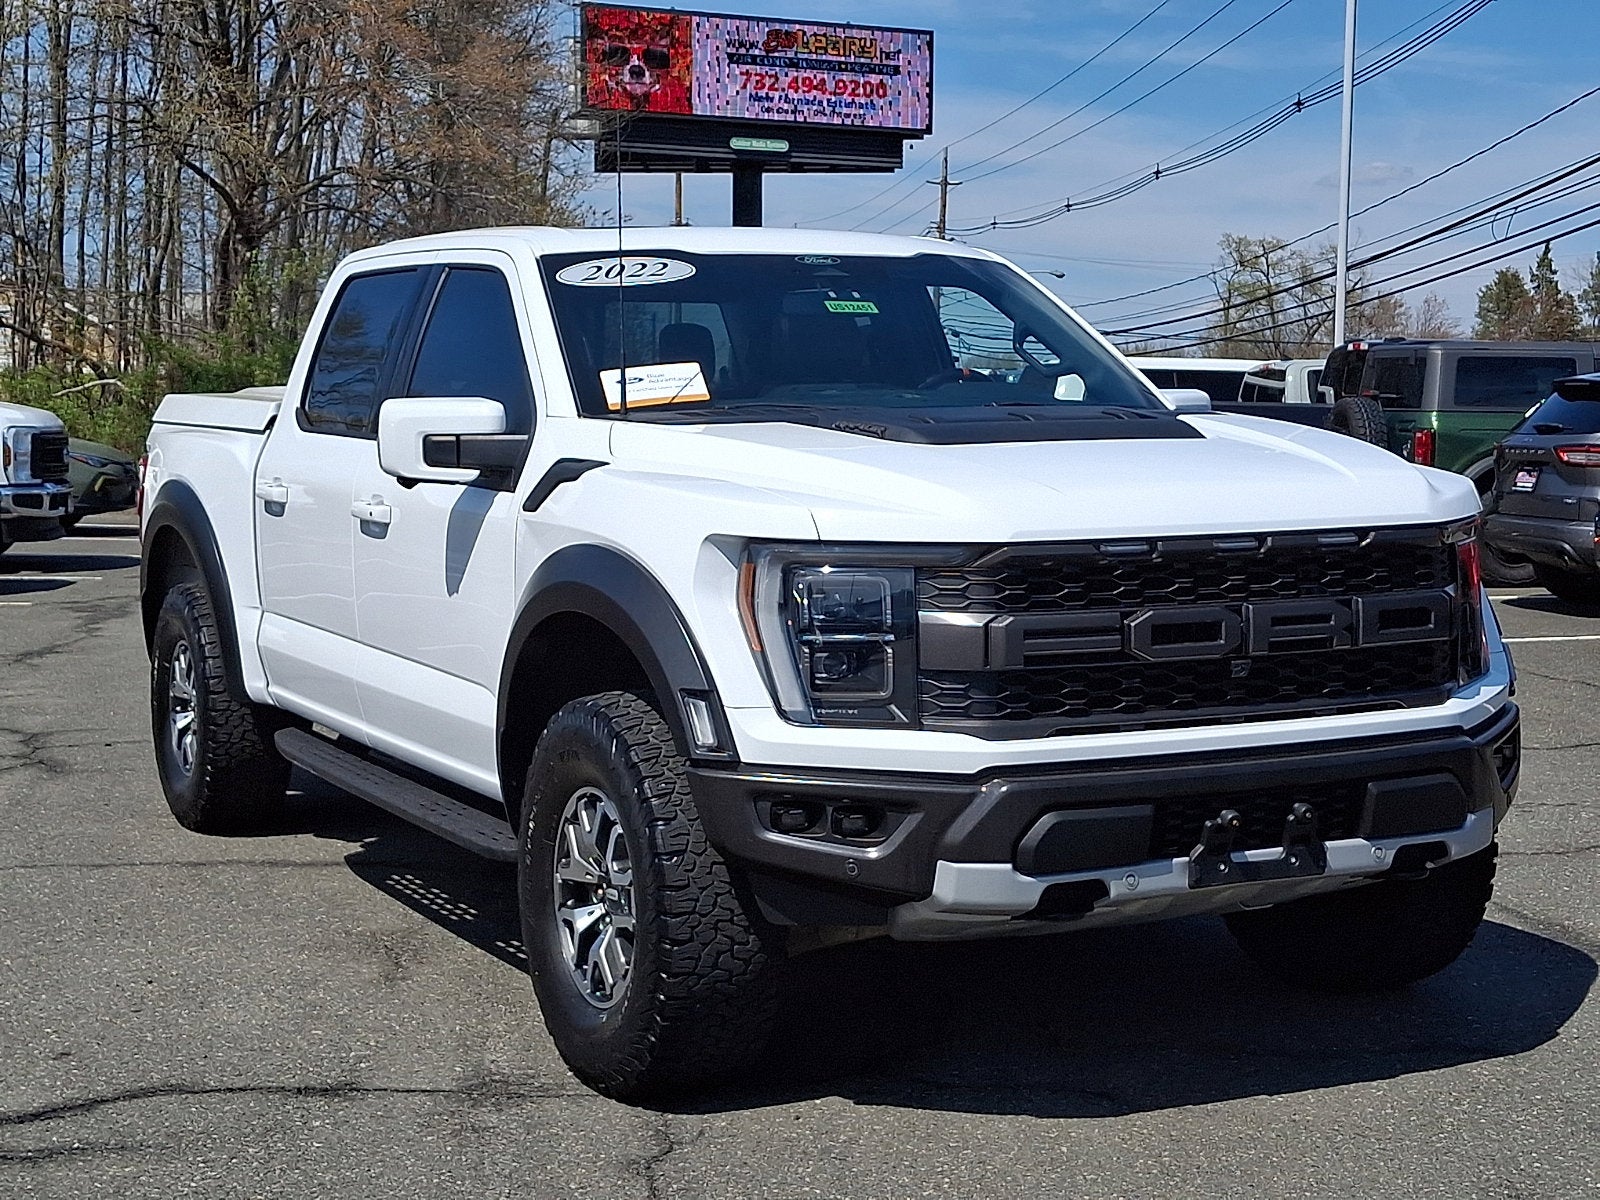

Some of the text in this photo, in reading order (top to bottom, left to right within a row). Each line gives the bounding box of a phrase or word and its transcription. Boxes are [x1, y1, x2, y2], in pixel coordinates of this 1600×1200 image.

[739, 70, 888, 99] 732.494.9200
[748, 92, 774, 103] New
[804, 256, 832, 264] Ford
[581, 261, 670, 282] 2022
[829, 303, 874, 312] US12451
[990, 590, 1457, 670] FORD
